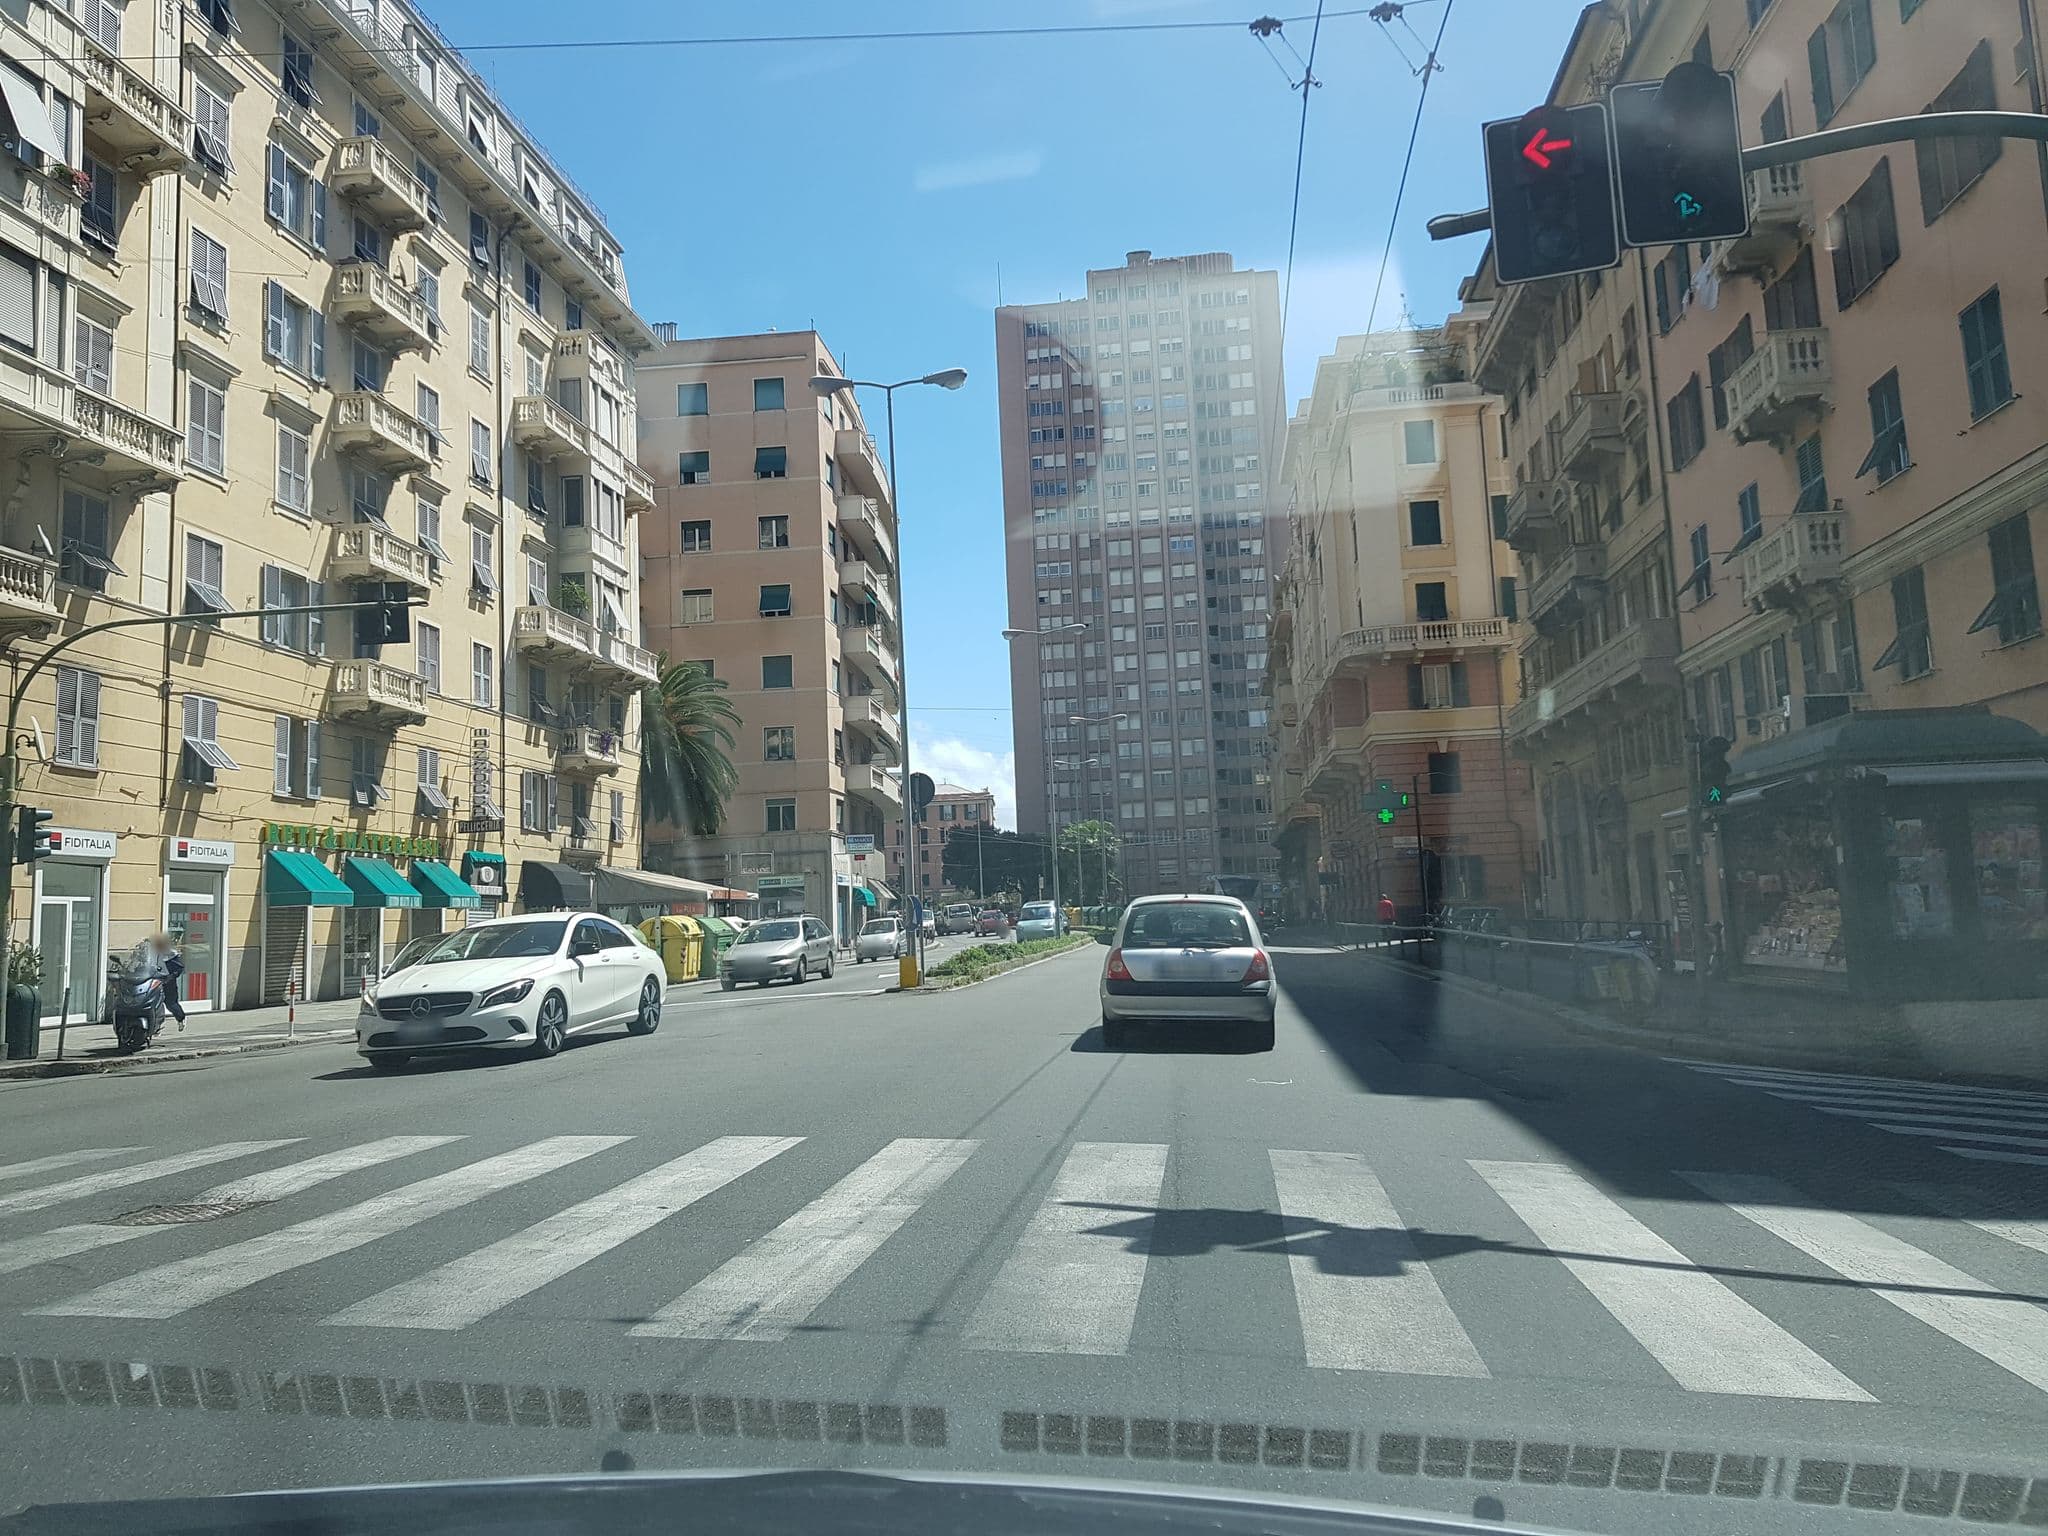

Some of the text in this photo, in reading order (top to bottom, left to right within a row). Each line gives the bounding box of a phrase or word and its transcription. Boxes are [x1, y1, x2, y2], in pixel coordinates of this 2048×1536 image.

[64, 837, 112, 850] FIDITALIA
[266, 823, 441, 857] RETI & MATERASSI
[189, 846, 228, 858] FIDITALIA
